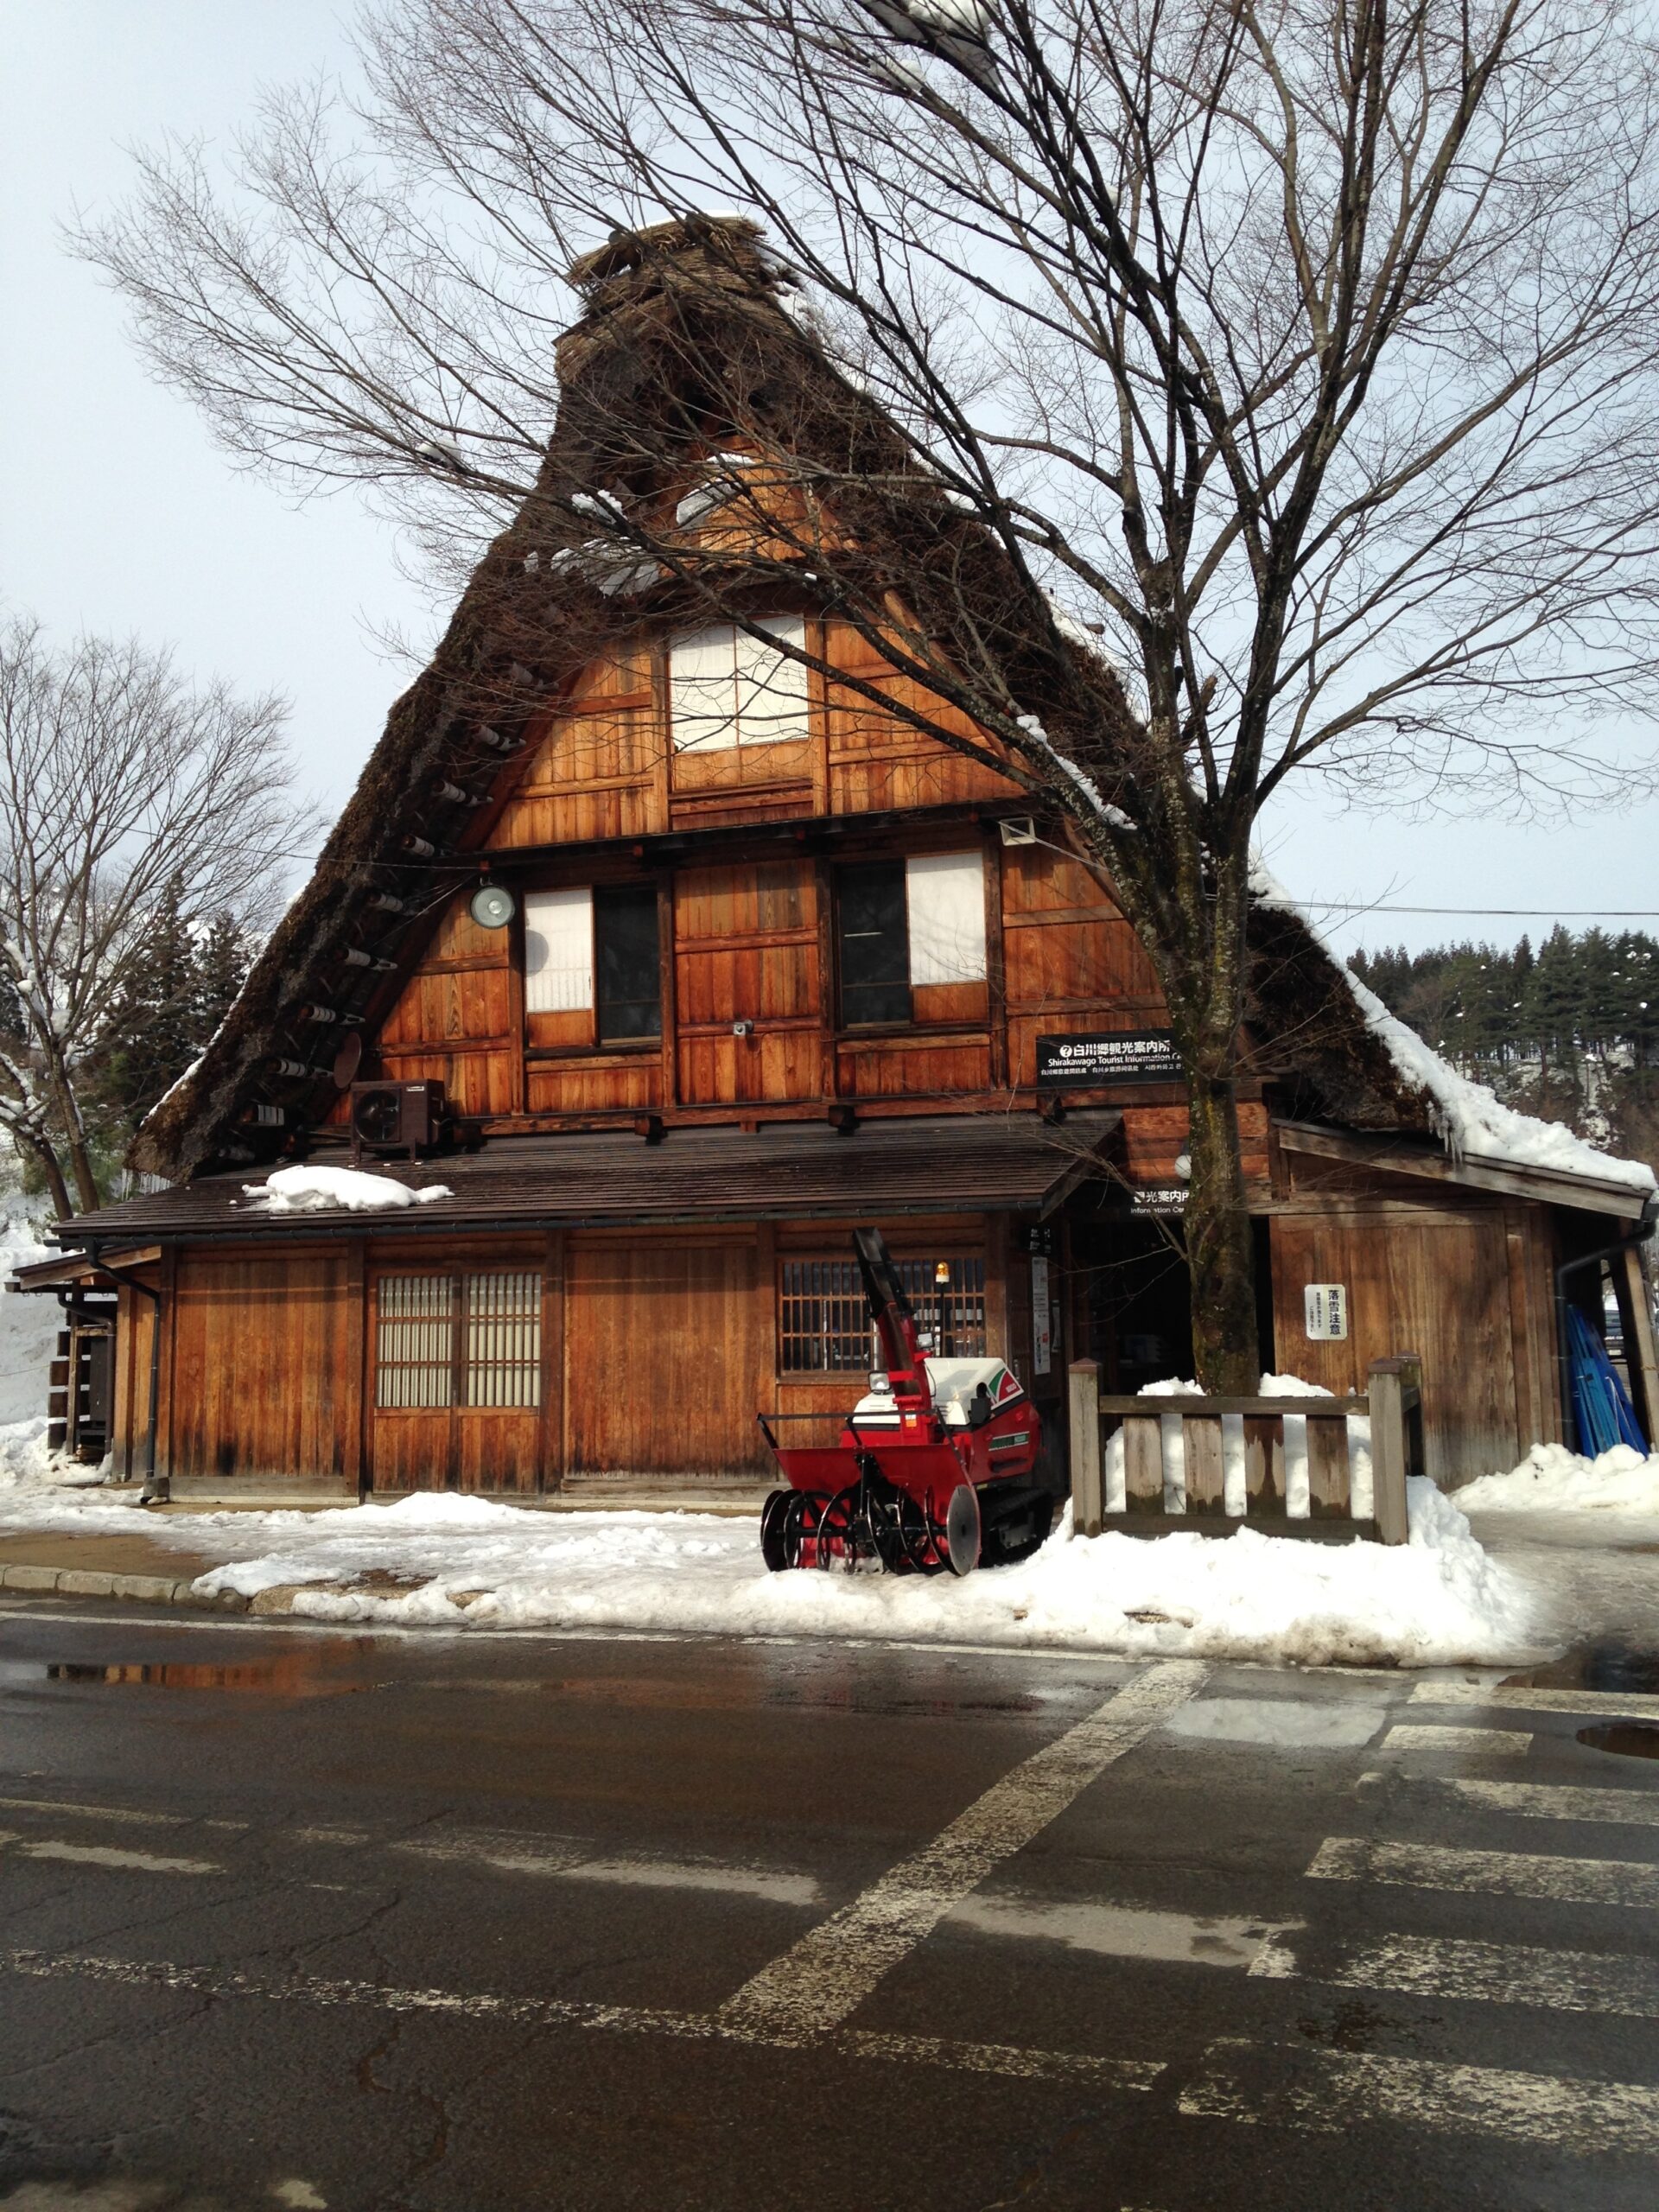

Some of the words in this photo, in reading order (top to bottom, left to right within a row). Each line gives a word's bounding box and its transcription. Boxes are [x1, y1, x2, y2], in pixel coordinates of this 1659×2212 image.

[1073, 1039, 1171, 1057] 白川郷観光案内所
[1048, 1058, 1096, 1067] Shirakawago
[1098, 1056, 1123, 1065] Tourist
[1125, 1053, 1171, 1064] Information
[1328, 1289, 1341, 1335] 落雪注意
